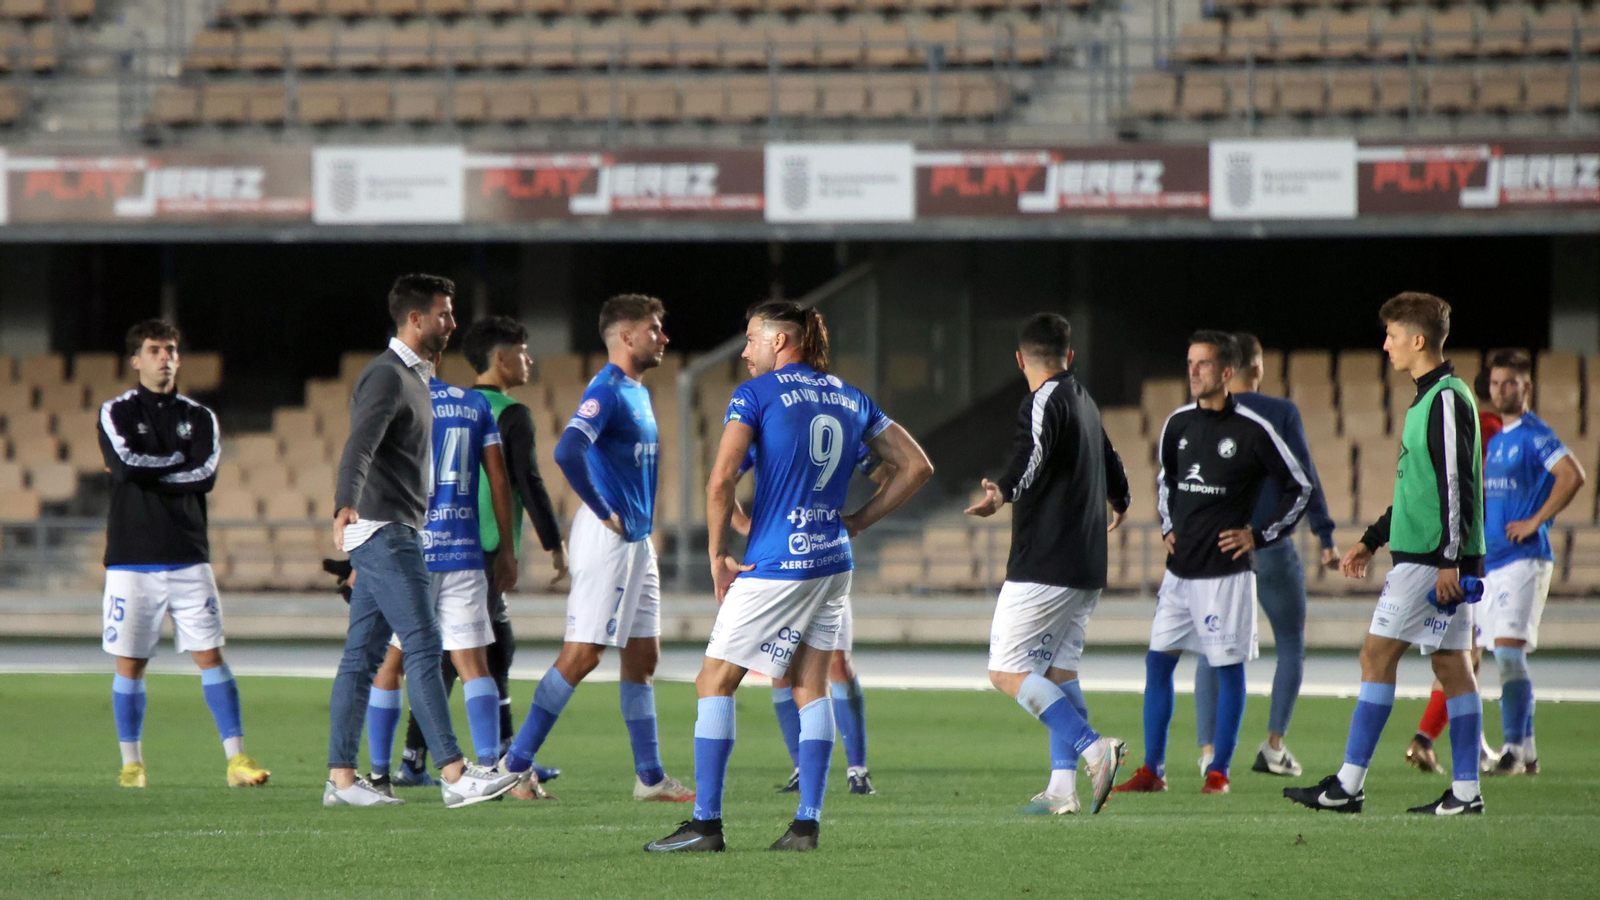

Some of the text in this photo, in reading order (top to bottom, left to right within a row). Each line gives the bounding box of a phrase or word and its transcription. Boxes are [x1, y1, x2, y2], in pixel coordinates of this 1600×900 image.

[930, 165, 1039, 196] PLAY
[1373, 161, 1480, 192] PLAY
[774, 372, 828, 387] indeso
[780, 388, 859, 412] DAVID AGUDO
[809, 414, 843, 491] 9
[1190, 484, 1226, 495] SPORTS
[810, 534, 826, 543] High
[780, 559, 815, 570] XEREZ
[108, 594, 126, 622] 15
[614, 586, 625, 613] 7
